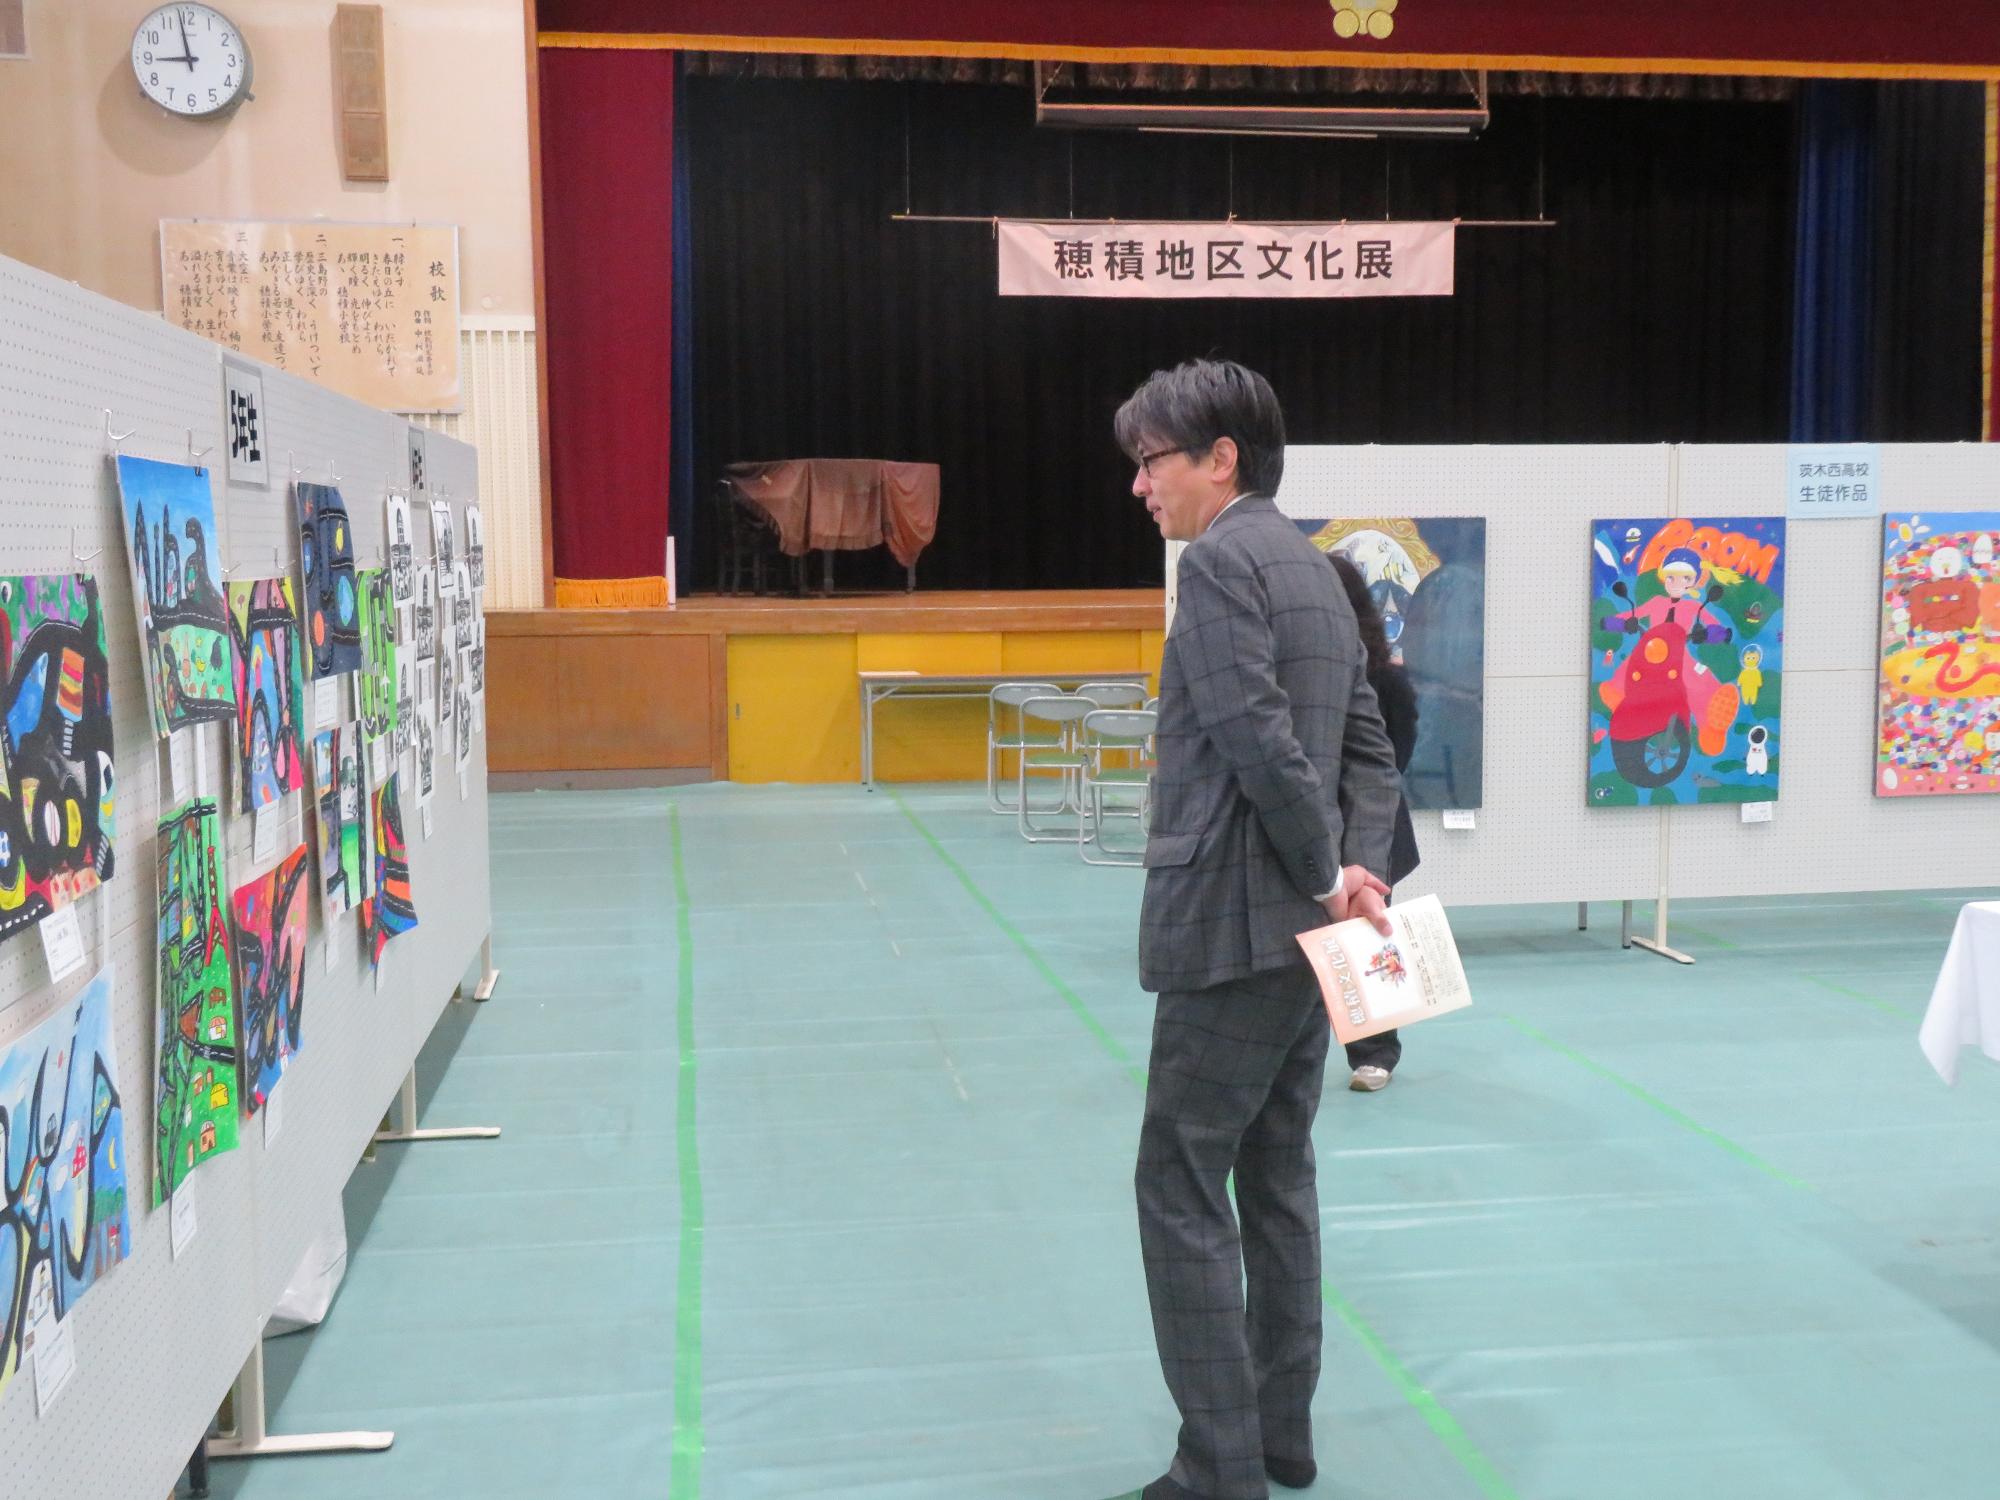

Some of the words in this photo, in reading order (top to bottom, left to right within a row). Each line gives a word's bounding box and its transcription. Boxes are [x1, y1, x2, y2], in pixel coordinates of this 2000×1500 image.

[162, 16, 172, 30] 11
[181, 11, 196, 26] 12
[147, 31, 159, 45] 10
[221, 33, 230, 47] 2
[143, 51, 153, 65] 9
[227, 54, 236, 68] 3
[150, 72, 159, 86] 8
[223, 75, 233, 88] 4
[166, 87, 175, 101] 7
[187, 94, 197, 107] 6
[208, 88, 217, 102] 5
[1054, 240, 1393, 281] 穂積地区文化展
[281, 252, 292, 286] 正しく
[359, 253, 370, 287] 明るく
[428, 260, 448, 302] 校歌
[230, 389, 261, 462] 5年生
[1799, 462, 1869, 478] 茨木西高校
[1799, 484, 1868, 502] 生徒作品
